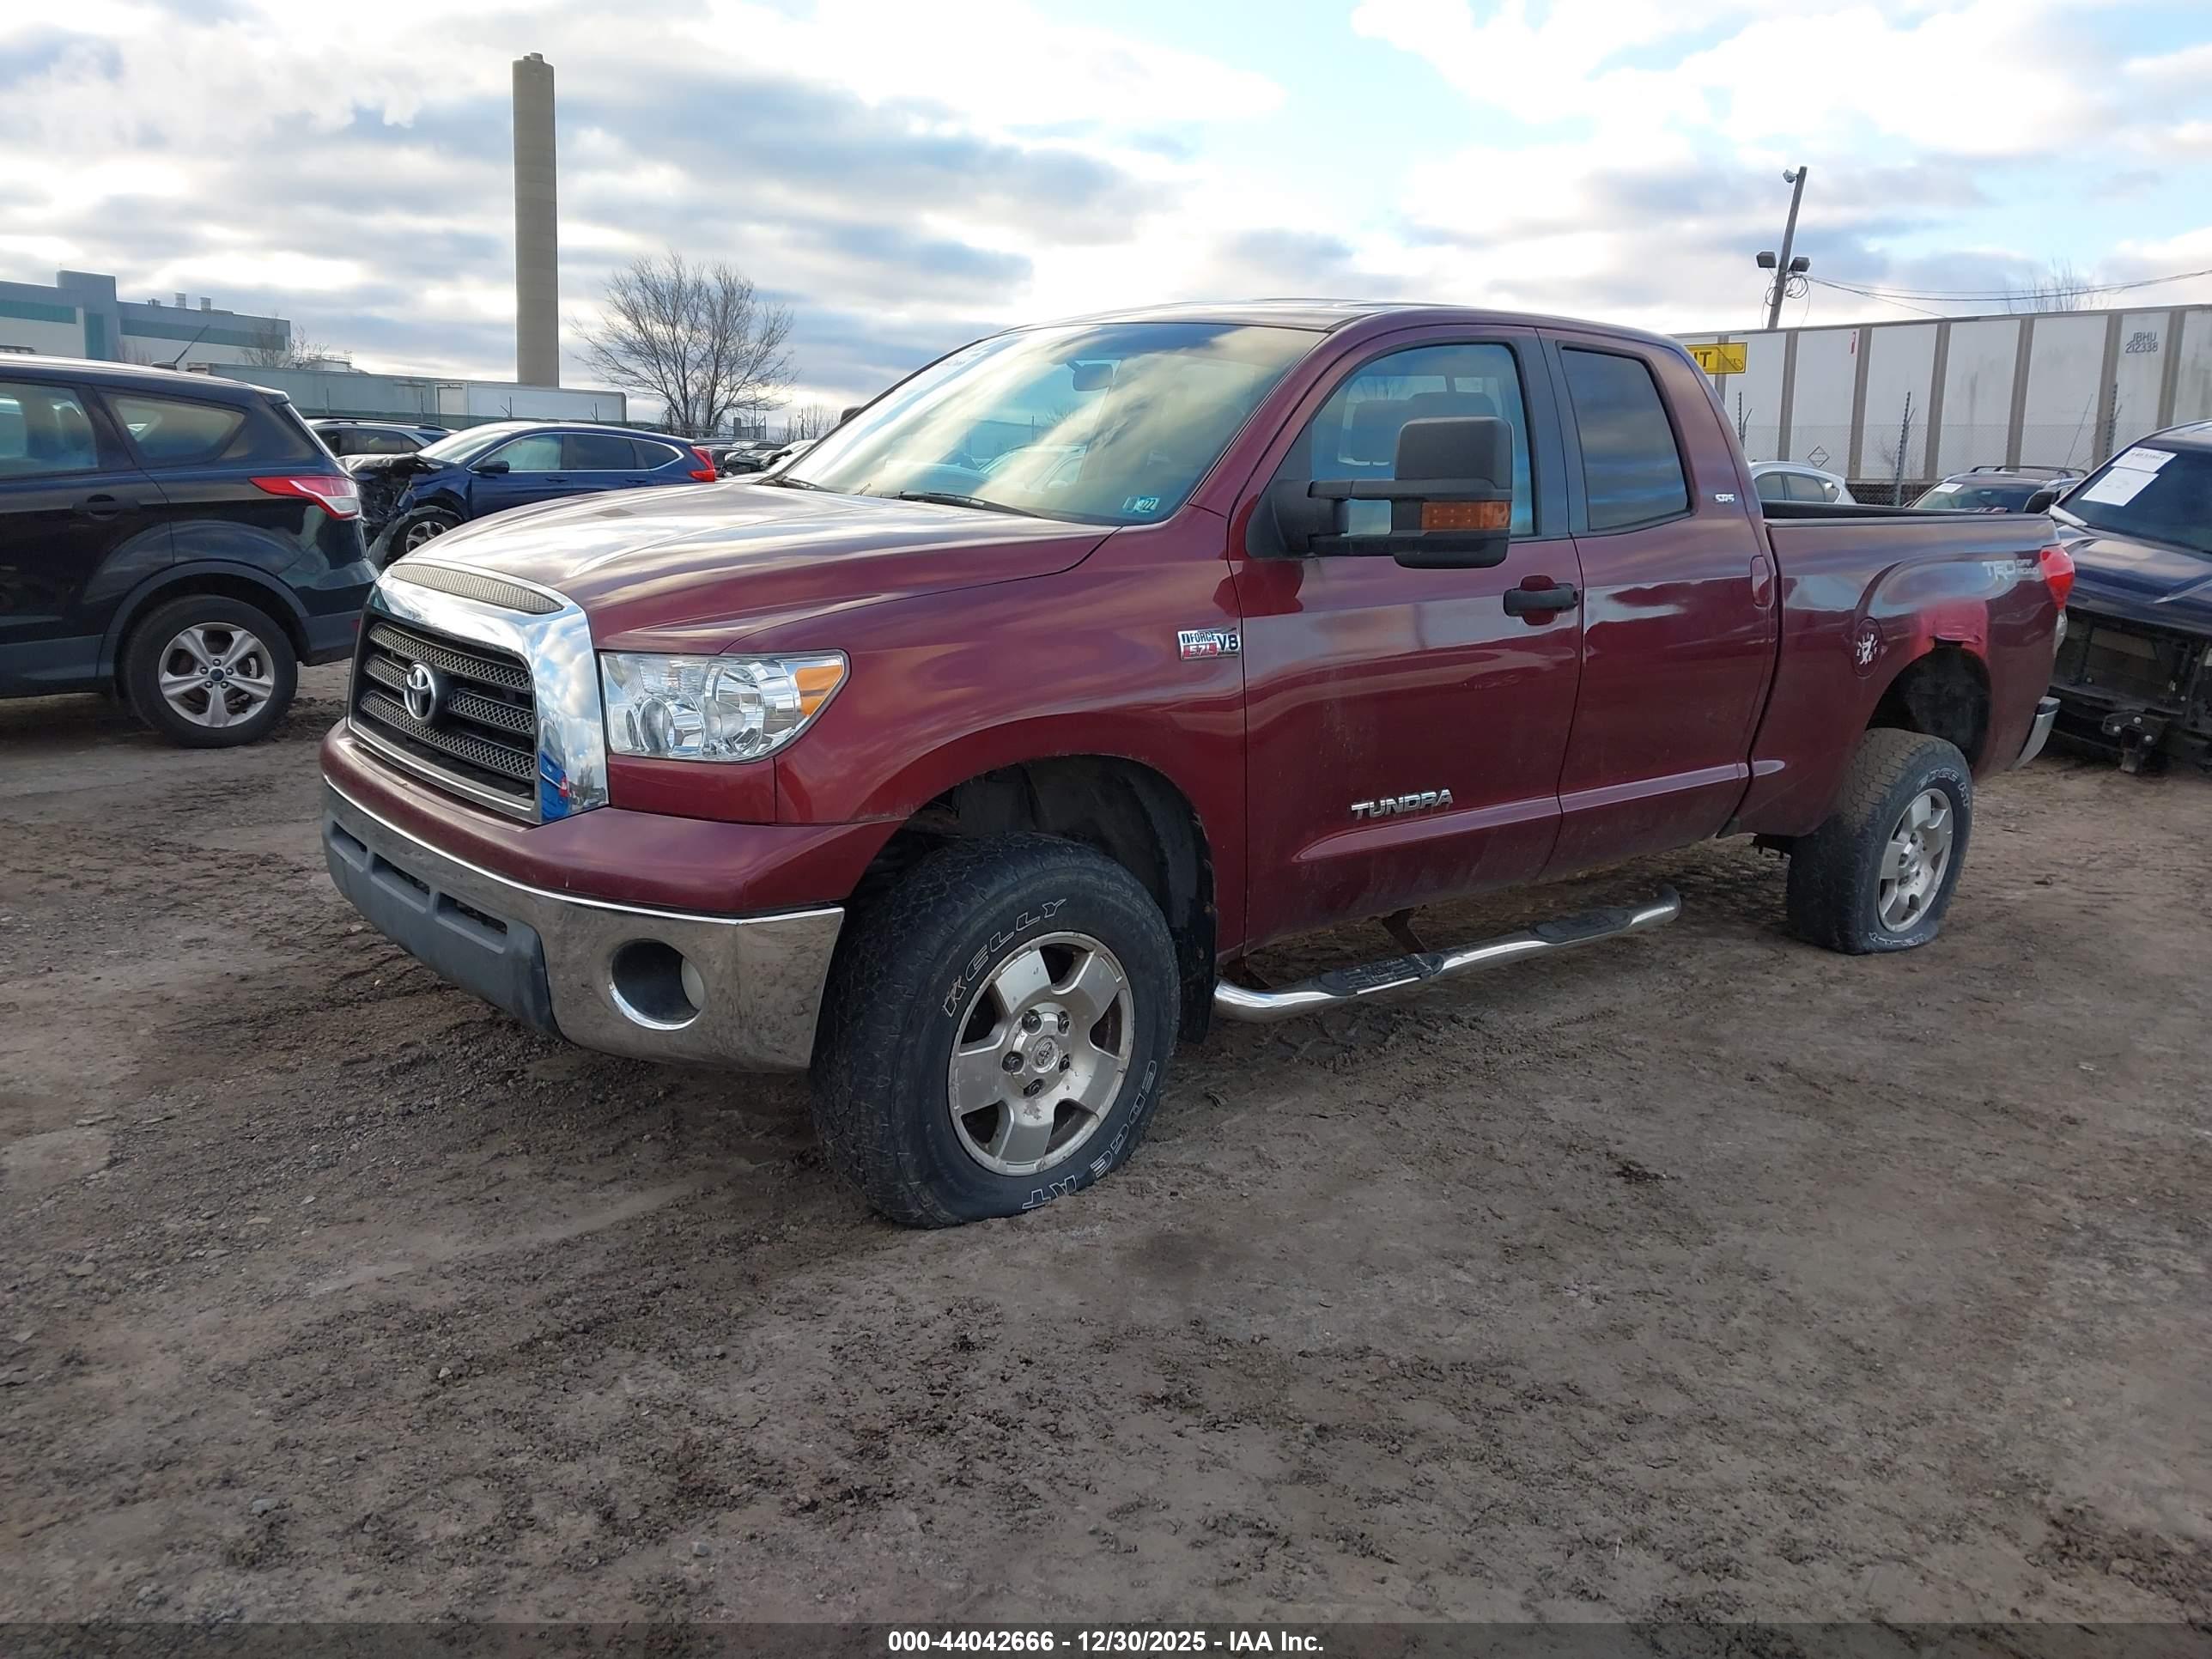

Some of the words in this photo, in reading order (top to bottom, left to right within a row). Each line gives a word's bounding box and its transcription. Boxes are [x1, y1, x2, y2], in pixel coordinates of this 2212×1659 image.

[2130, 331, 2157, 343] JBHU
[1216, 634, 1239, 651] V8
[1351, 788, 1454, 820] TUNDRA
[941, 897, 1067, 1018] KELLY
[1089, 1060, 1158, 1178] EDGE
[1021, 1173, 1078, 1210] AT
